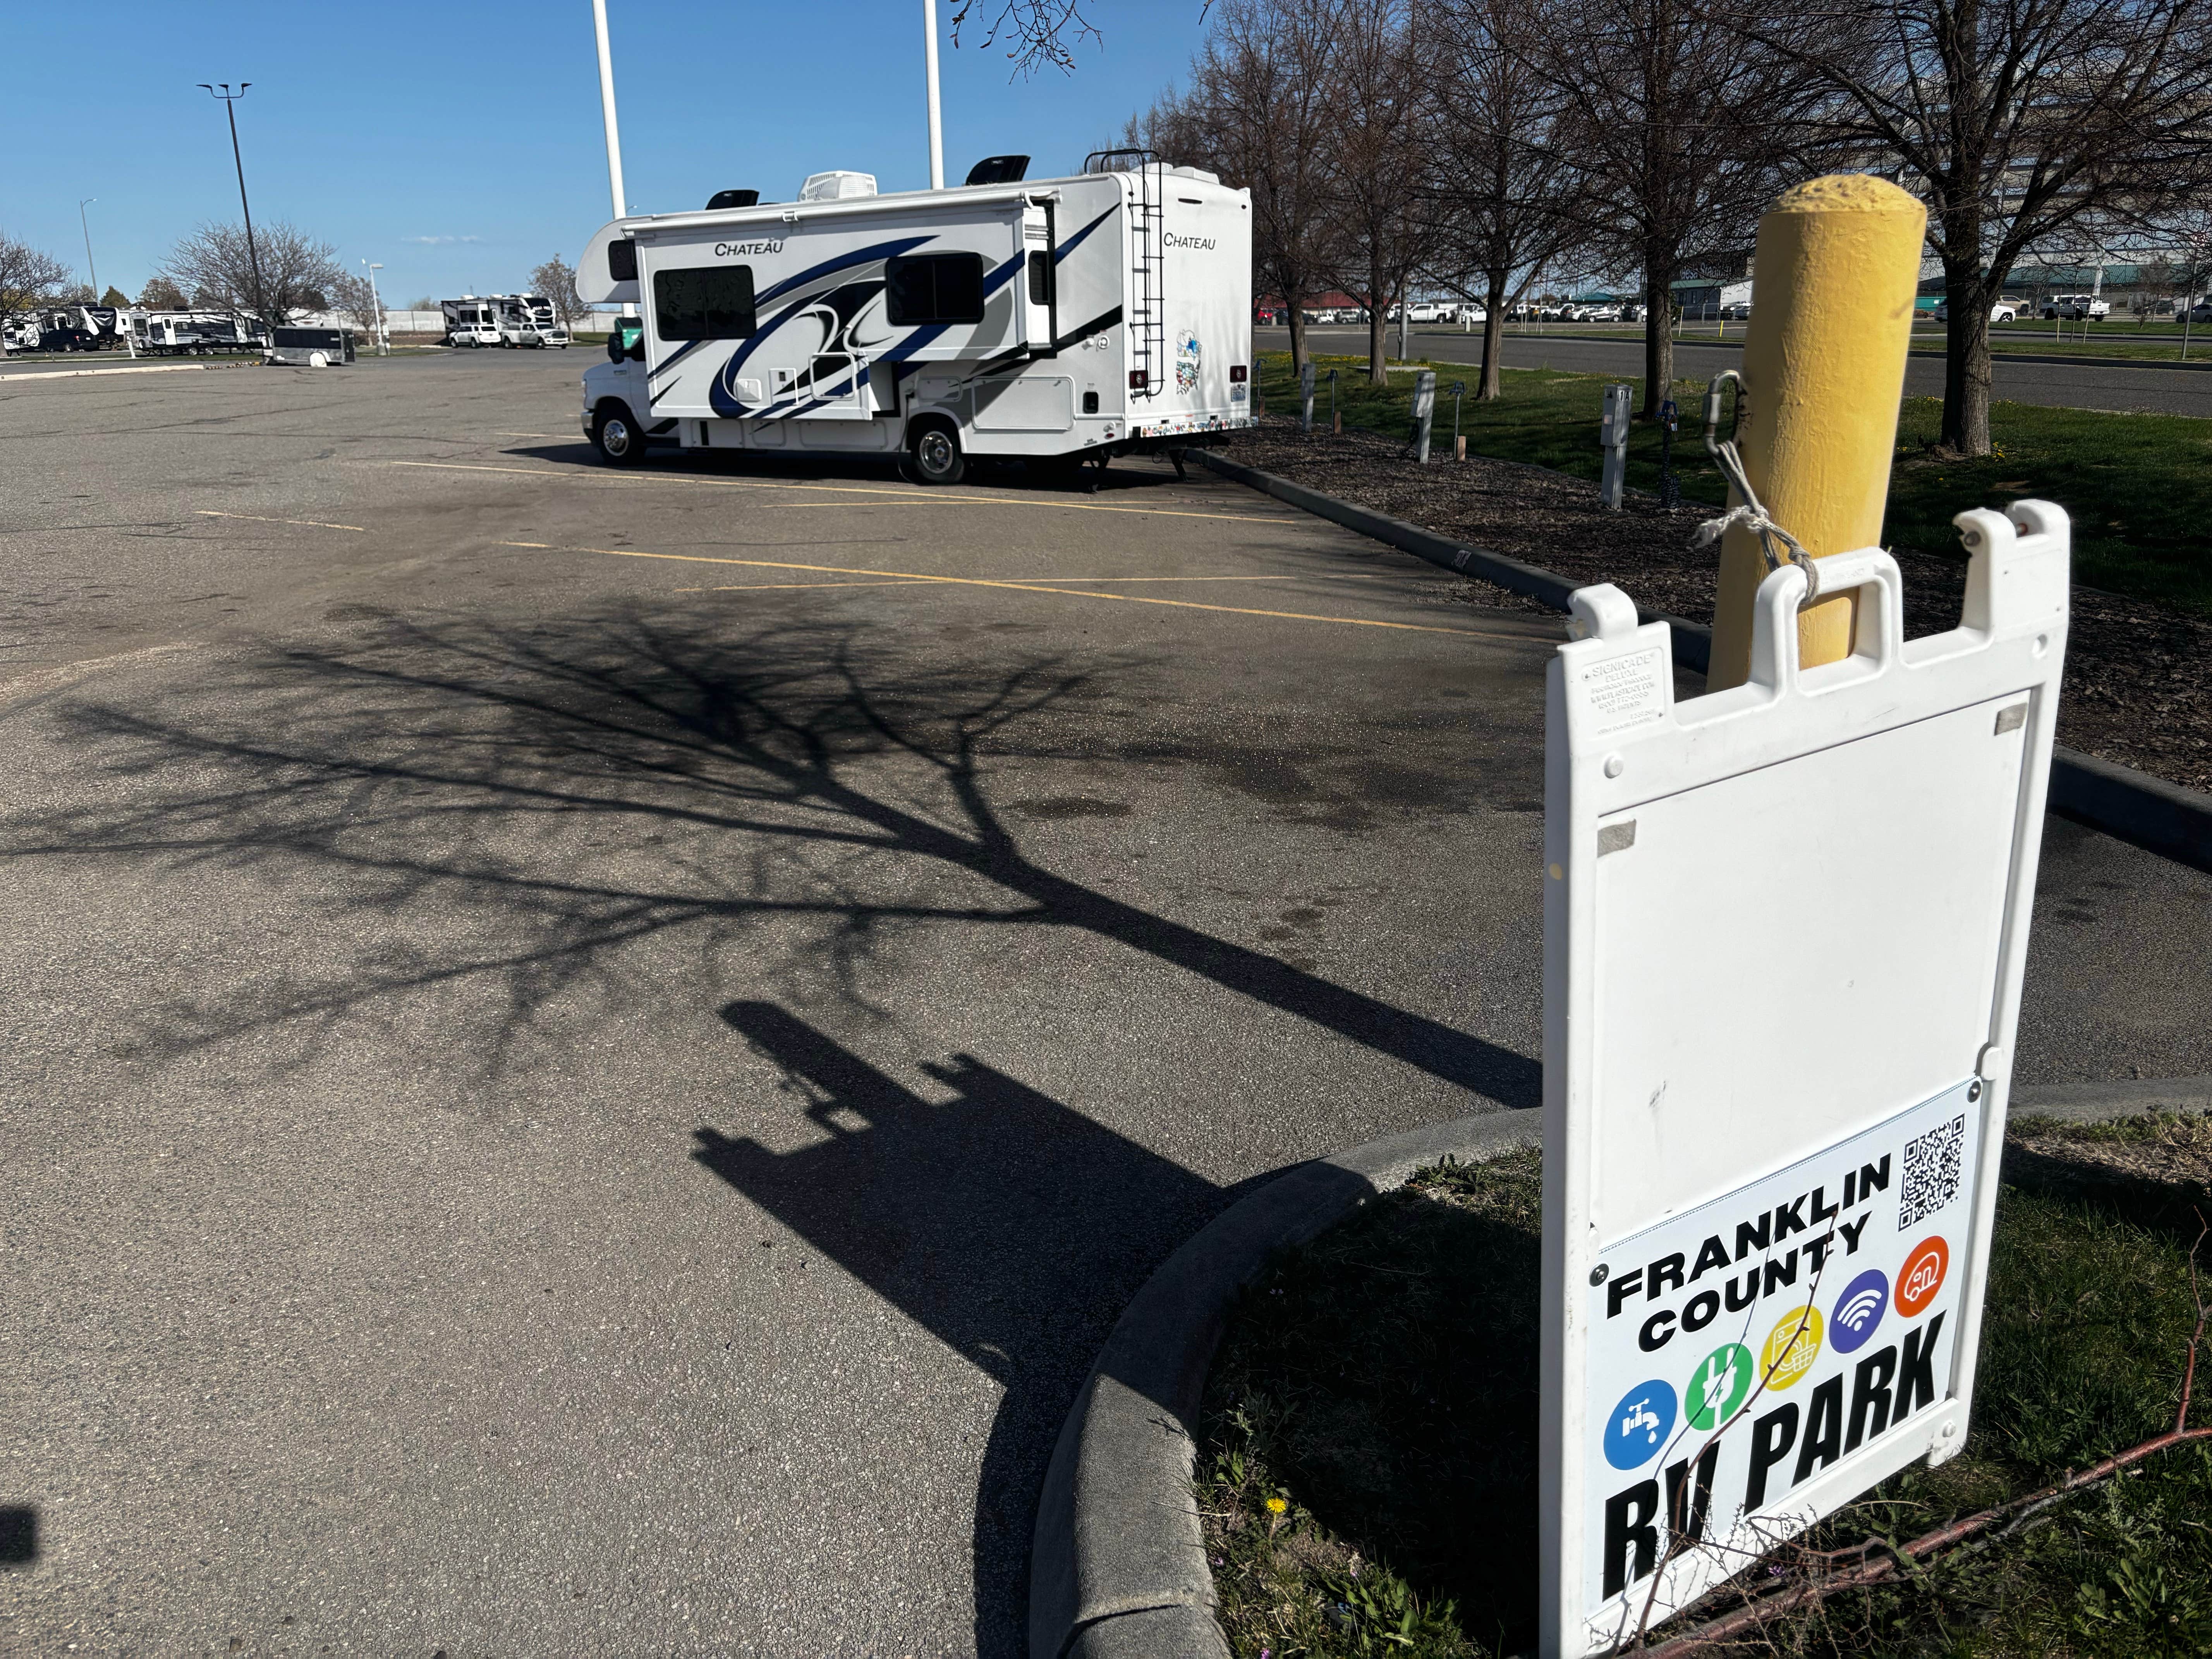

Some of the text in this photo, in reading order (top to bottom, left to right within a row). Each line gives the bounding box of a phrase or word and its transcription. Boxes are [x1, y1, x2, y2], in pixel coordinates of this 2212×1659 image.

[715, 242, 783, 256] CHATEAU
[1164, 232, 1216, 250] CHATEAU
[1592, 654, 1651, 677] SIGNICADE
[1607, 1153, 1891, 1320] FRANKLIN
[1638, 1211, 1873, 1352] COUNTY
[1602, 1309, 1947, 1602] RV PARK
